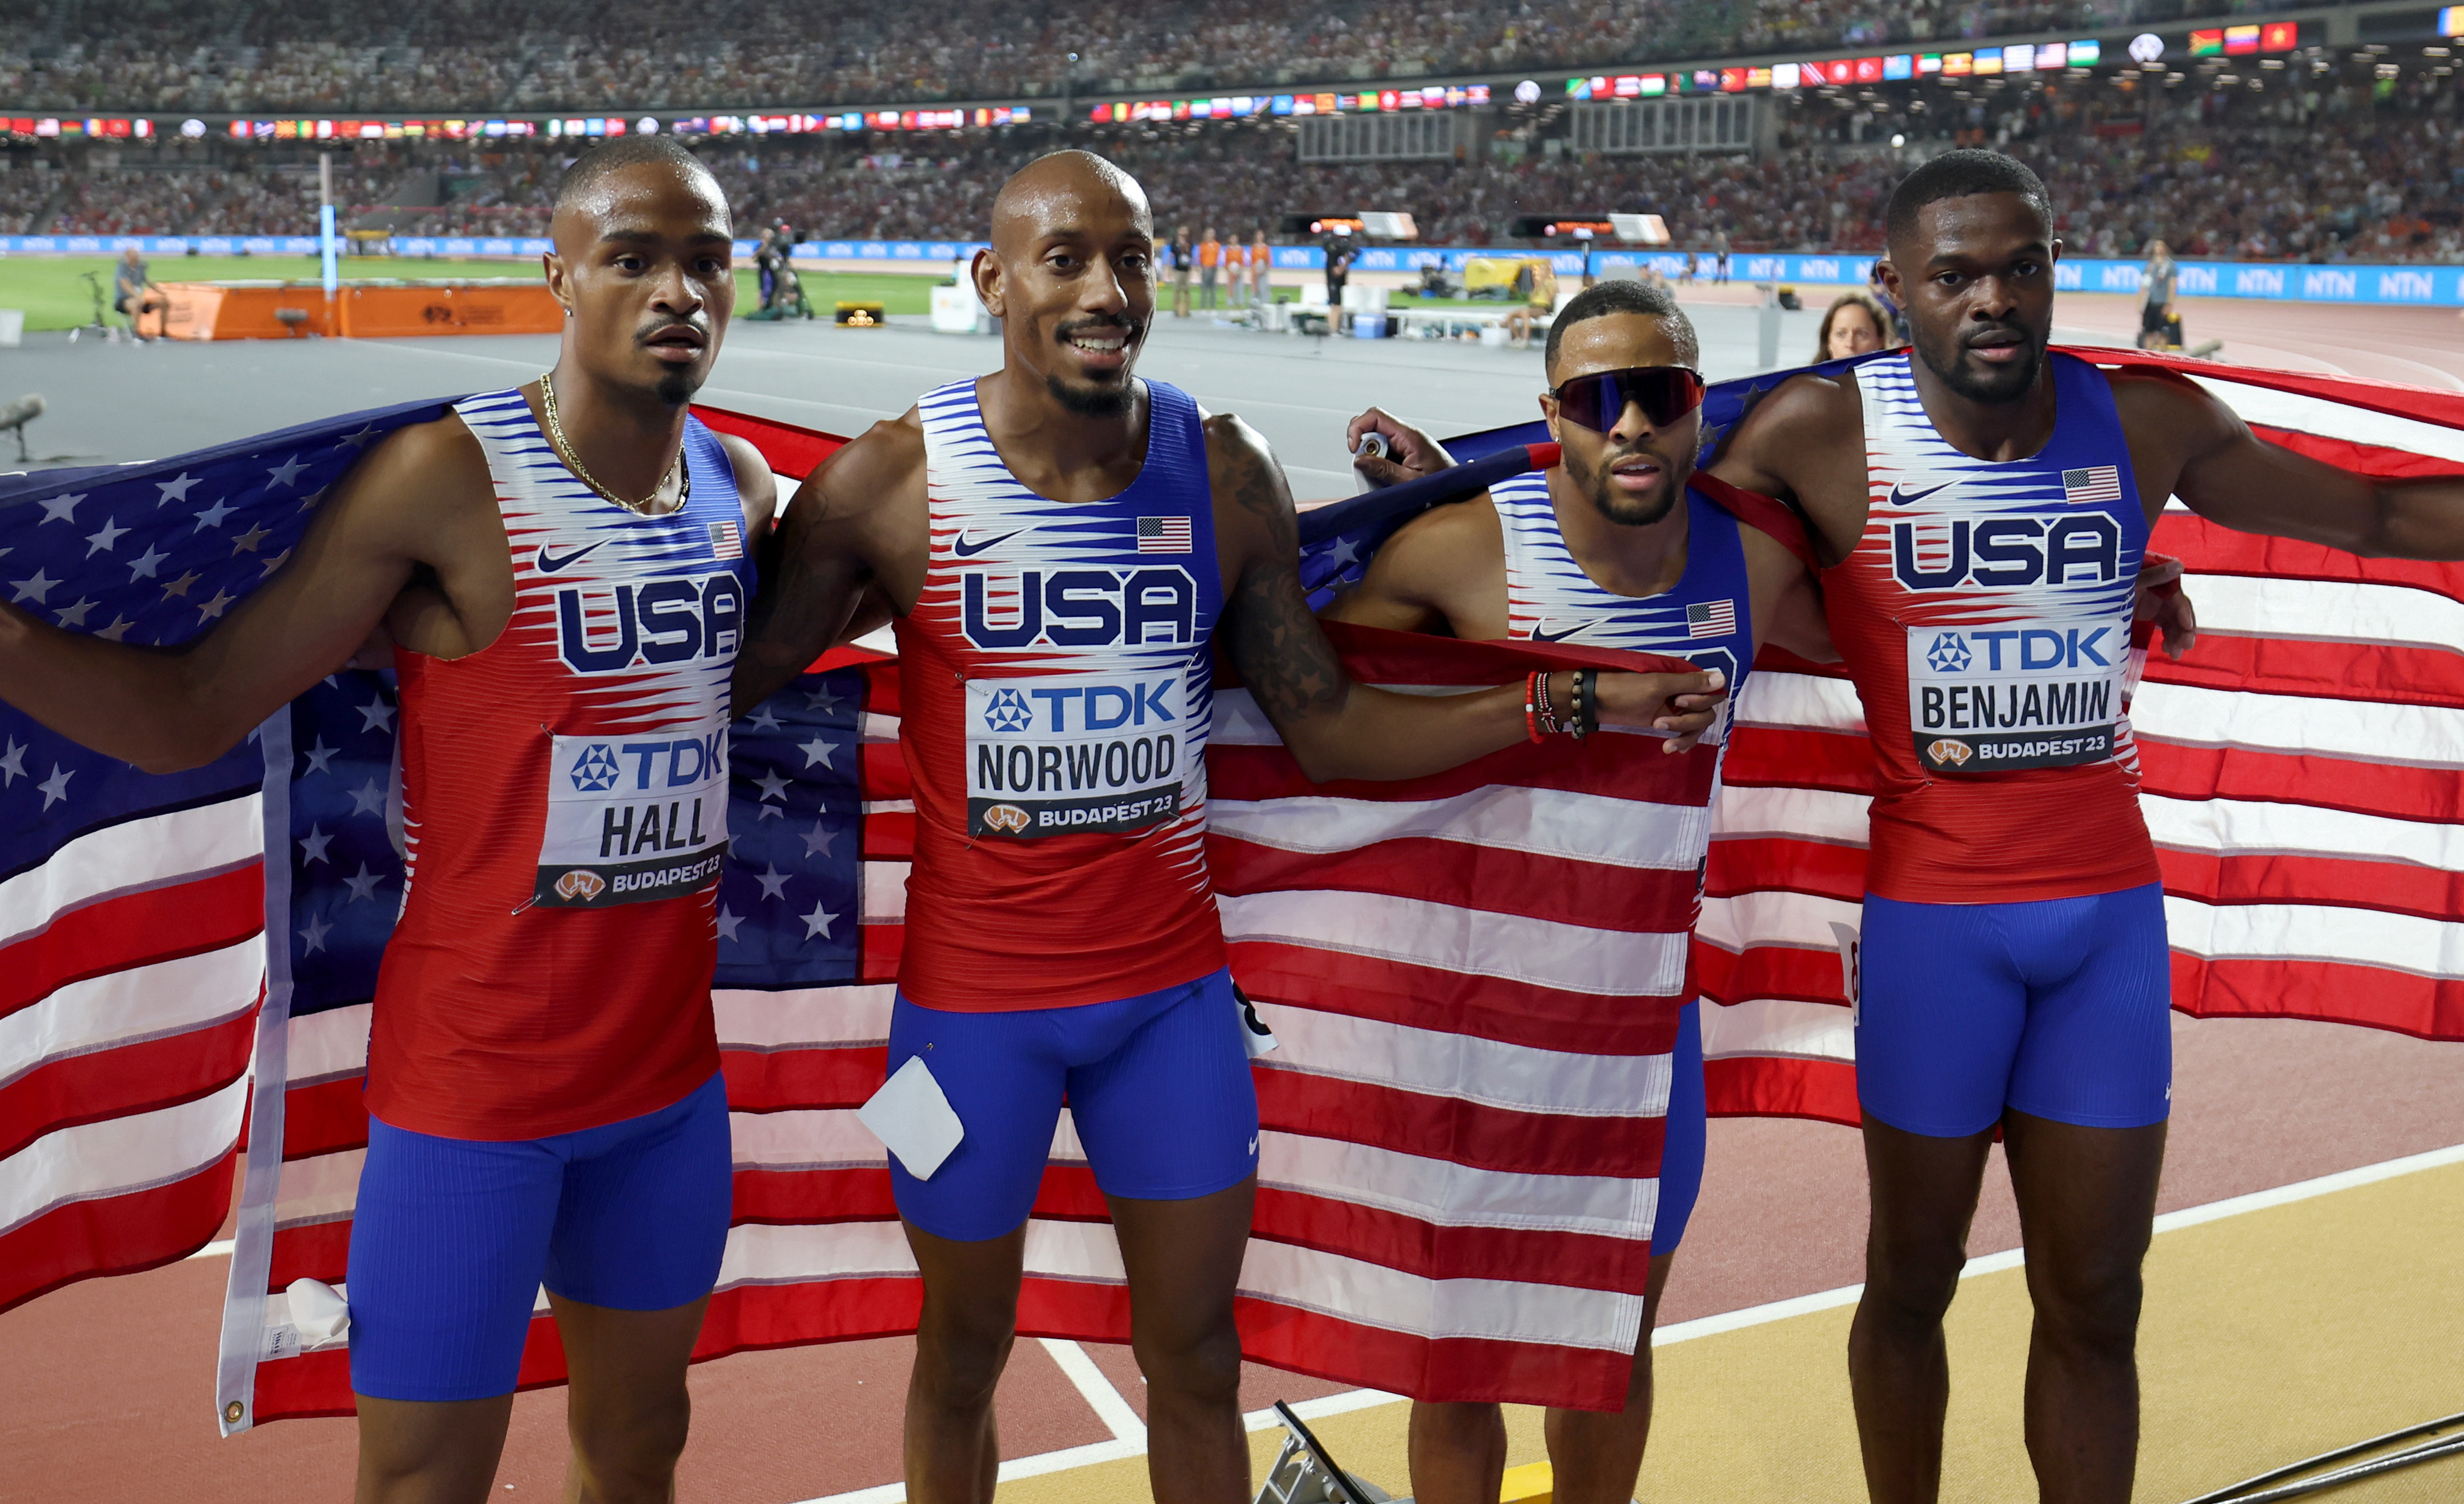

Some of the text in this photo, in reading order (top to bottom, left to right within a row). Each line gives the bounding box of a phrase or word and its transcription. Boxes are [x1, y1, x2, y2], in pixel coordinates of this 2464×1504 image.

[1748, 258, 1785, 278] NTN
[1800, 259, 1839, 279] NTN
[2237, 268, 2284, 293] NTN
[2304, 270, 2356, 298] NTN
[2378, 271, 2433, 299] NTN
[1890, 511, 2122, 594] USA
[554, 570, 744, 676] USA
[960, 564, 1197, 653] USA
[1971, 626, 2112, 671] TDK
[1031, 677, 1177, 732] TDK
[1922, 679, 2111, 729] BENJAMIN
[622, 727, 724, 790] TDK
[978, 733, 1175, 792] NORWOOD
[600, 797, 706, 858] HALL
